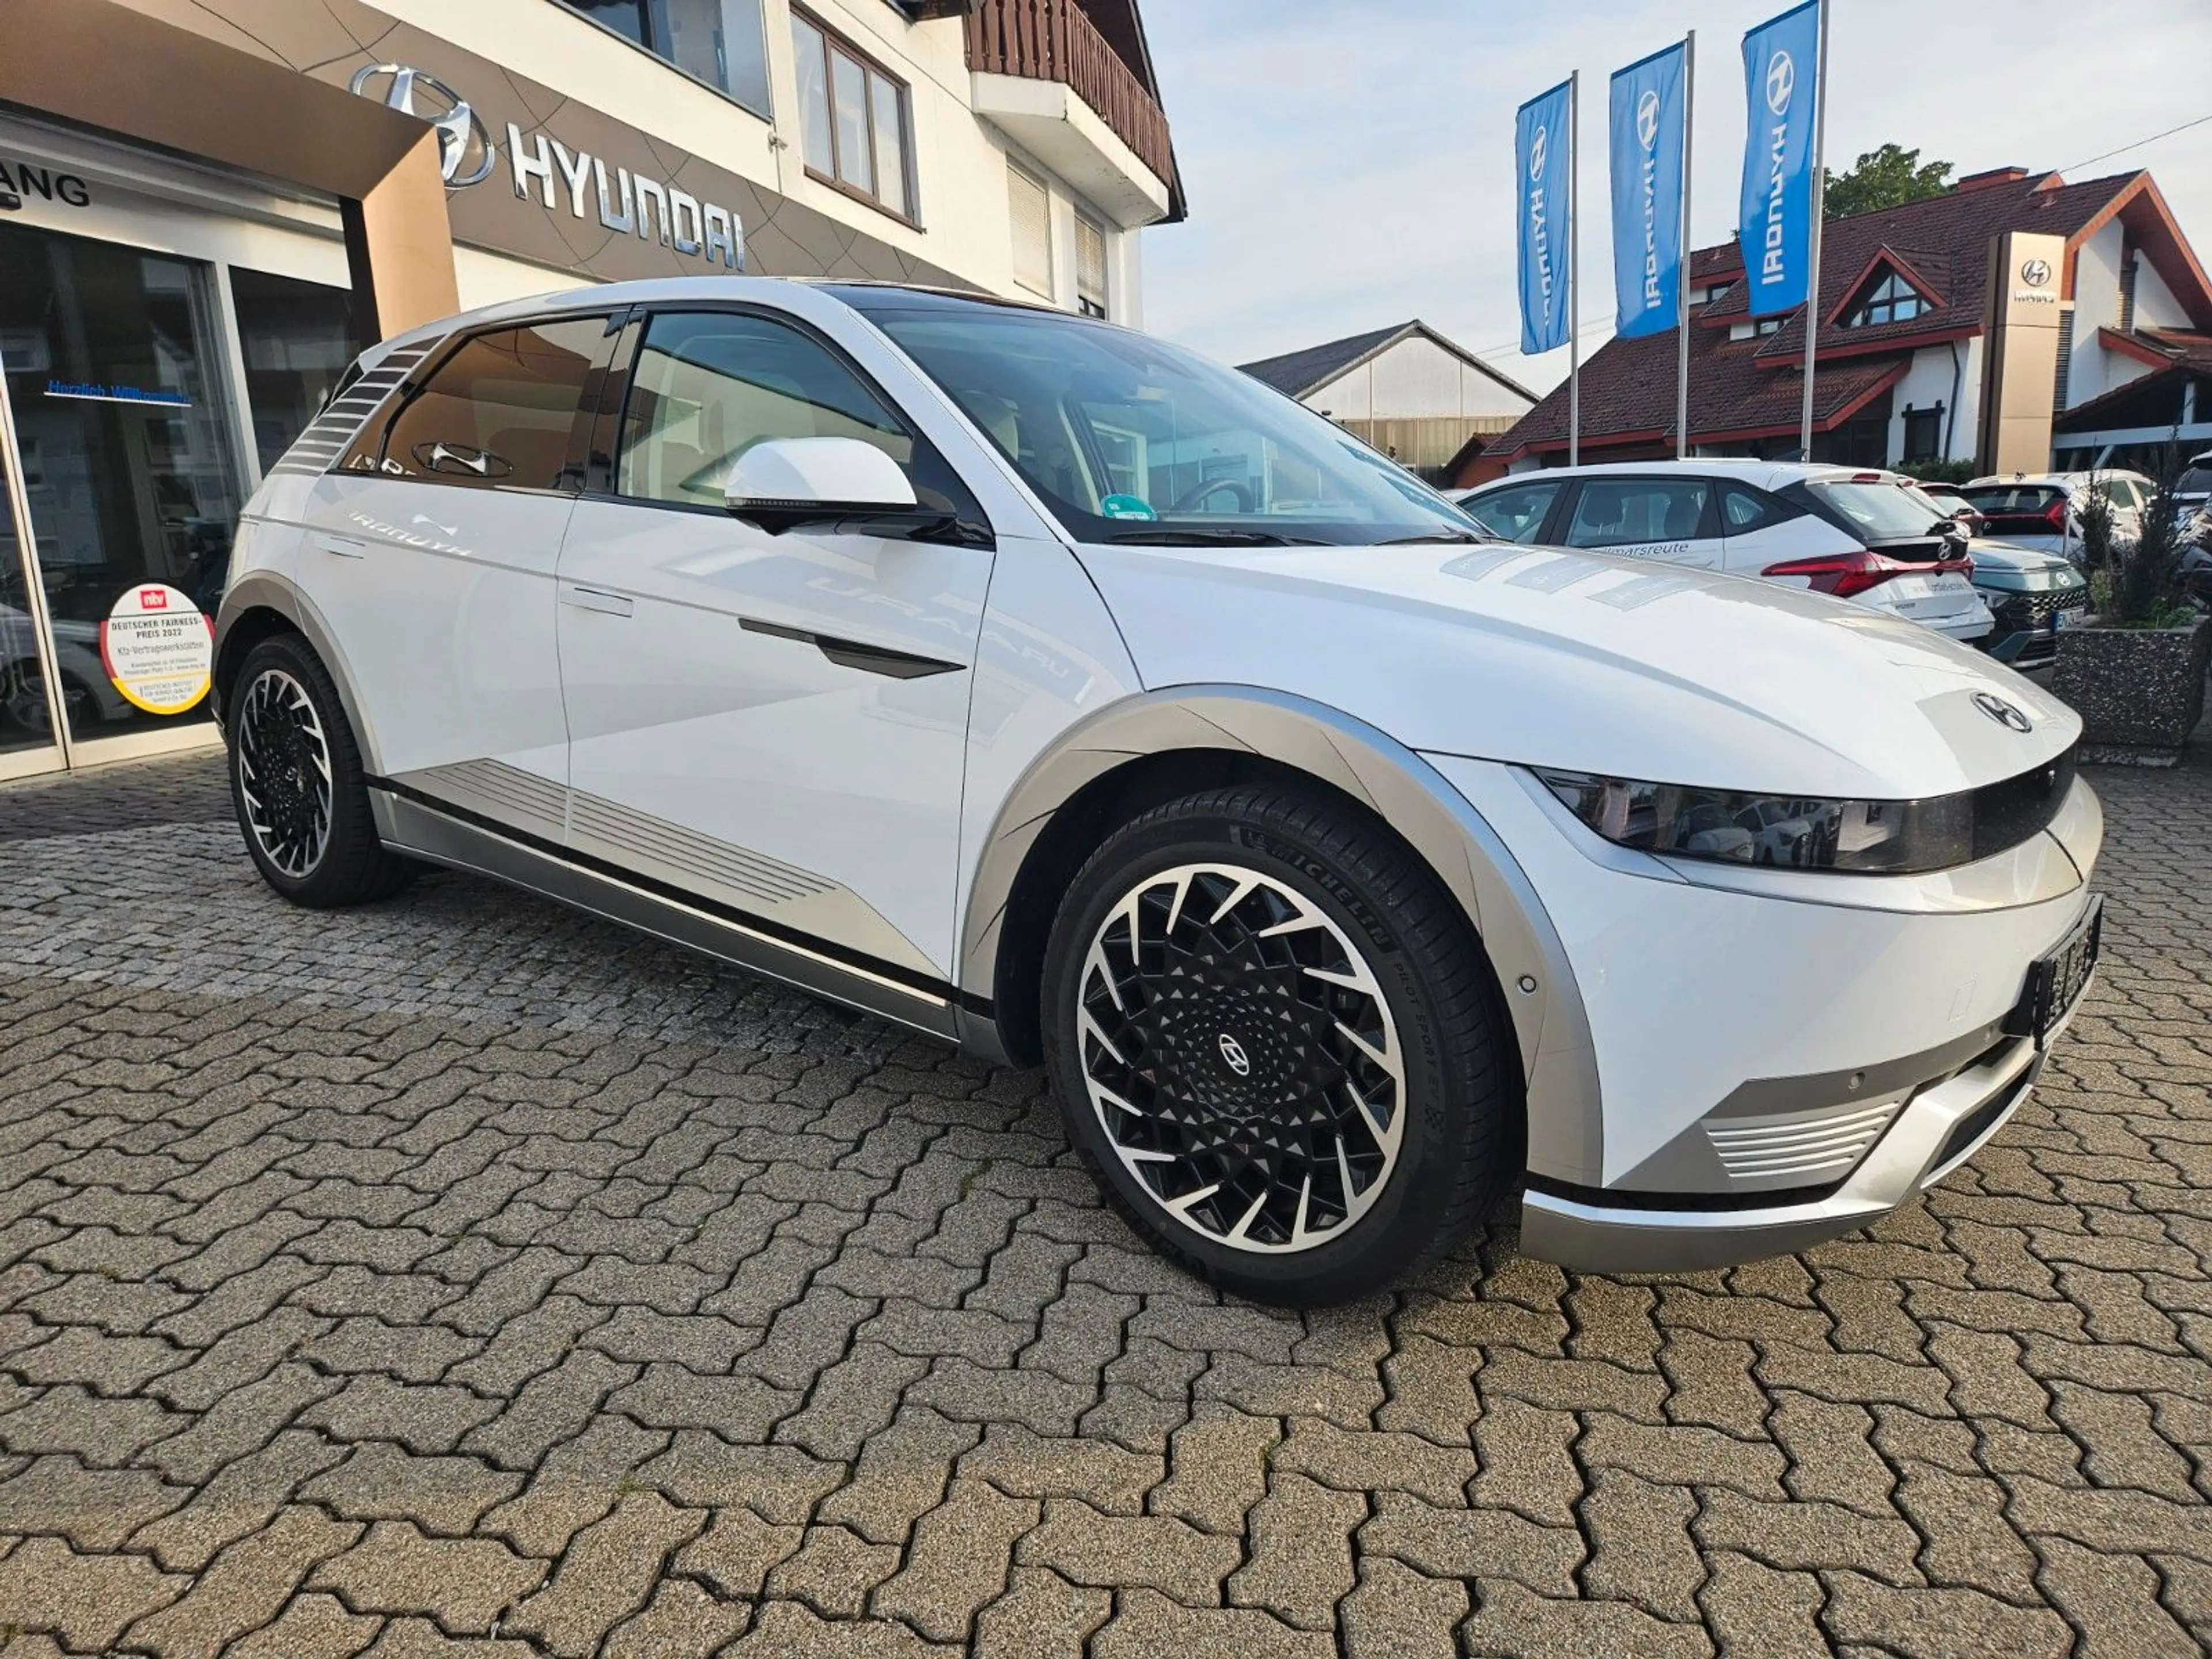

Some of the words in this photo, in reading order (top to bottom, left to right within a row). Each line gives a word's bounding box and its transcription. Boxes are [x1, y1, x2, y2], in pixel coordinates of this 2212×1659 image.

[506, 122, 745, 272] HYUNDAI
[1762, 123, 1787, 285] HYUNDAI
[48, 380, 105, 396] Herzlich
[144, 592, 165, 607] ntv
[112, 619, 160, 631] DEUTSCHER
[162, 617, 202, 628] FAIRNESS-
[137, 630, 160, 639] PREIS
[1393, 963, 1421, 1006] PILOT
[1415, 1013, 1437, 1068] SPORT
